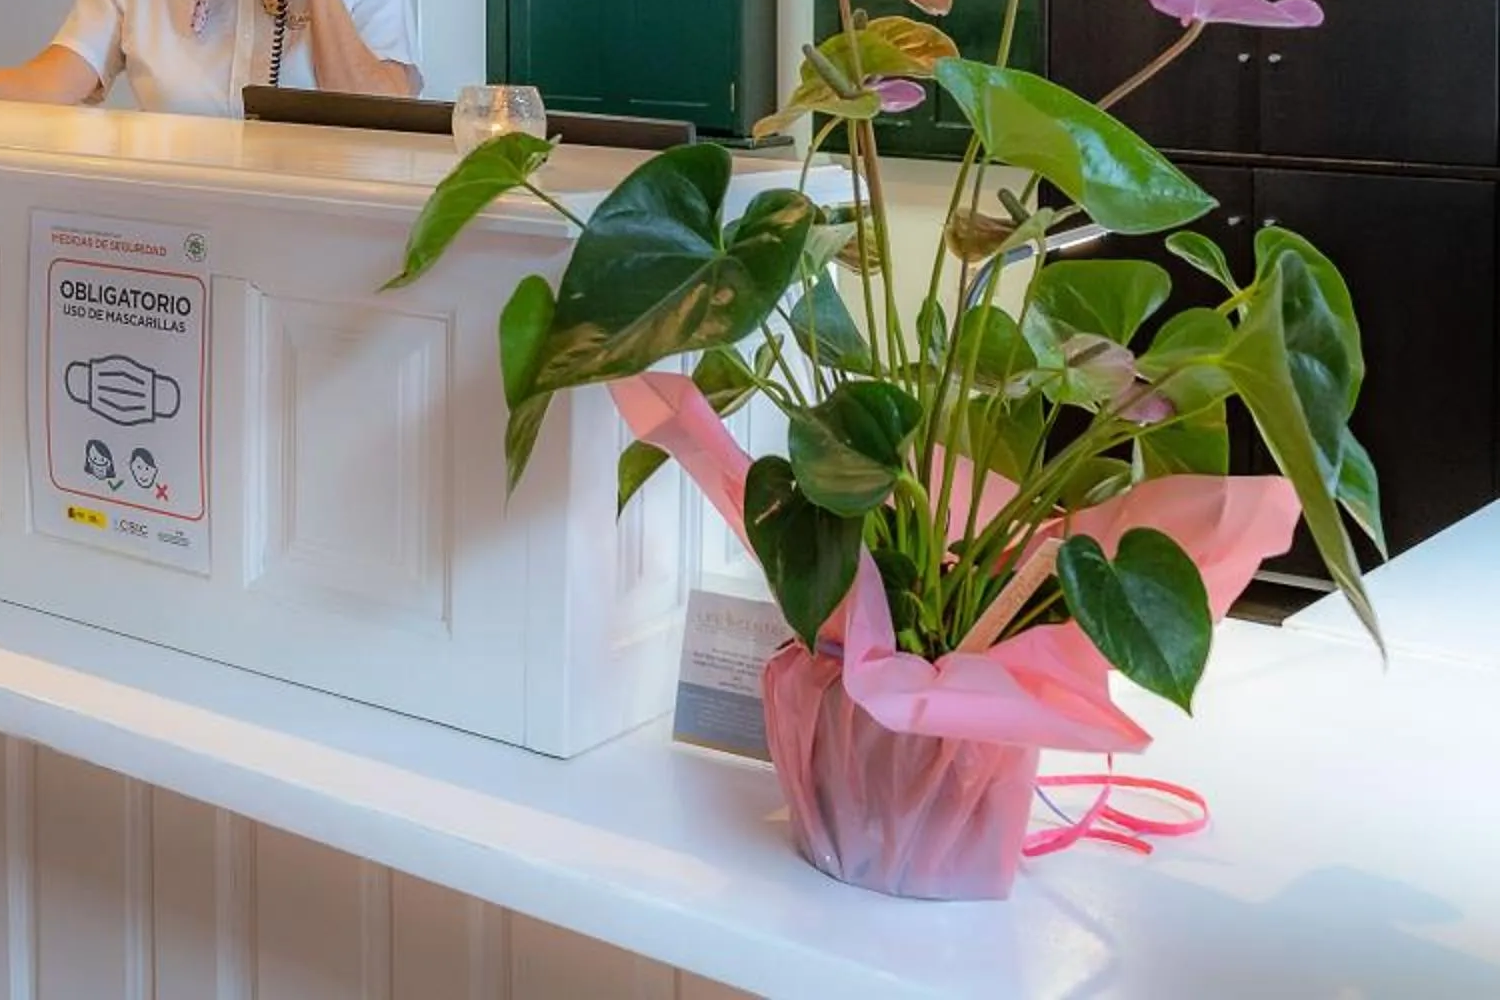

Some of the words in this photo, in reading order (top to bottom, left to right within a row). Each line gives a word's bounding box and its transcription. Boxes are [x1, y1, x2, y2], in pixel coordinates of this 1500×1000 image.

[59, 280, 192, 316] OBLIGATORIO
[63, 303, 86, 317] USO
[88, 307, 104, 321] DE
[106, 311, 186, 333] MASCARILLAS
